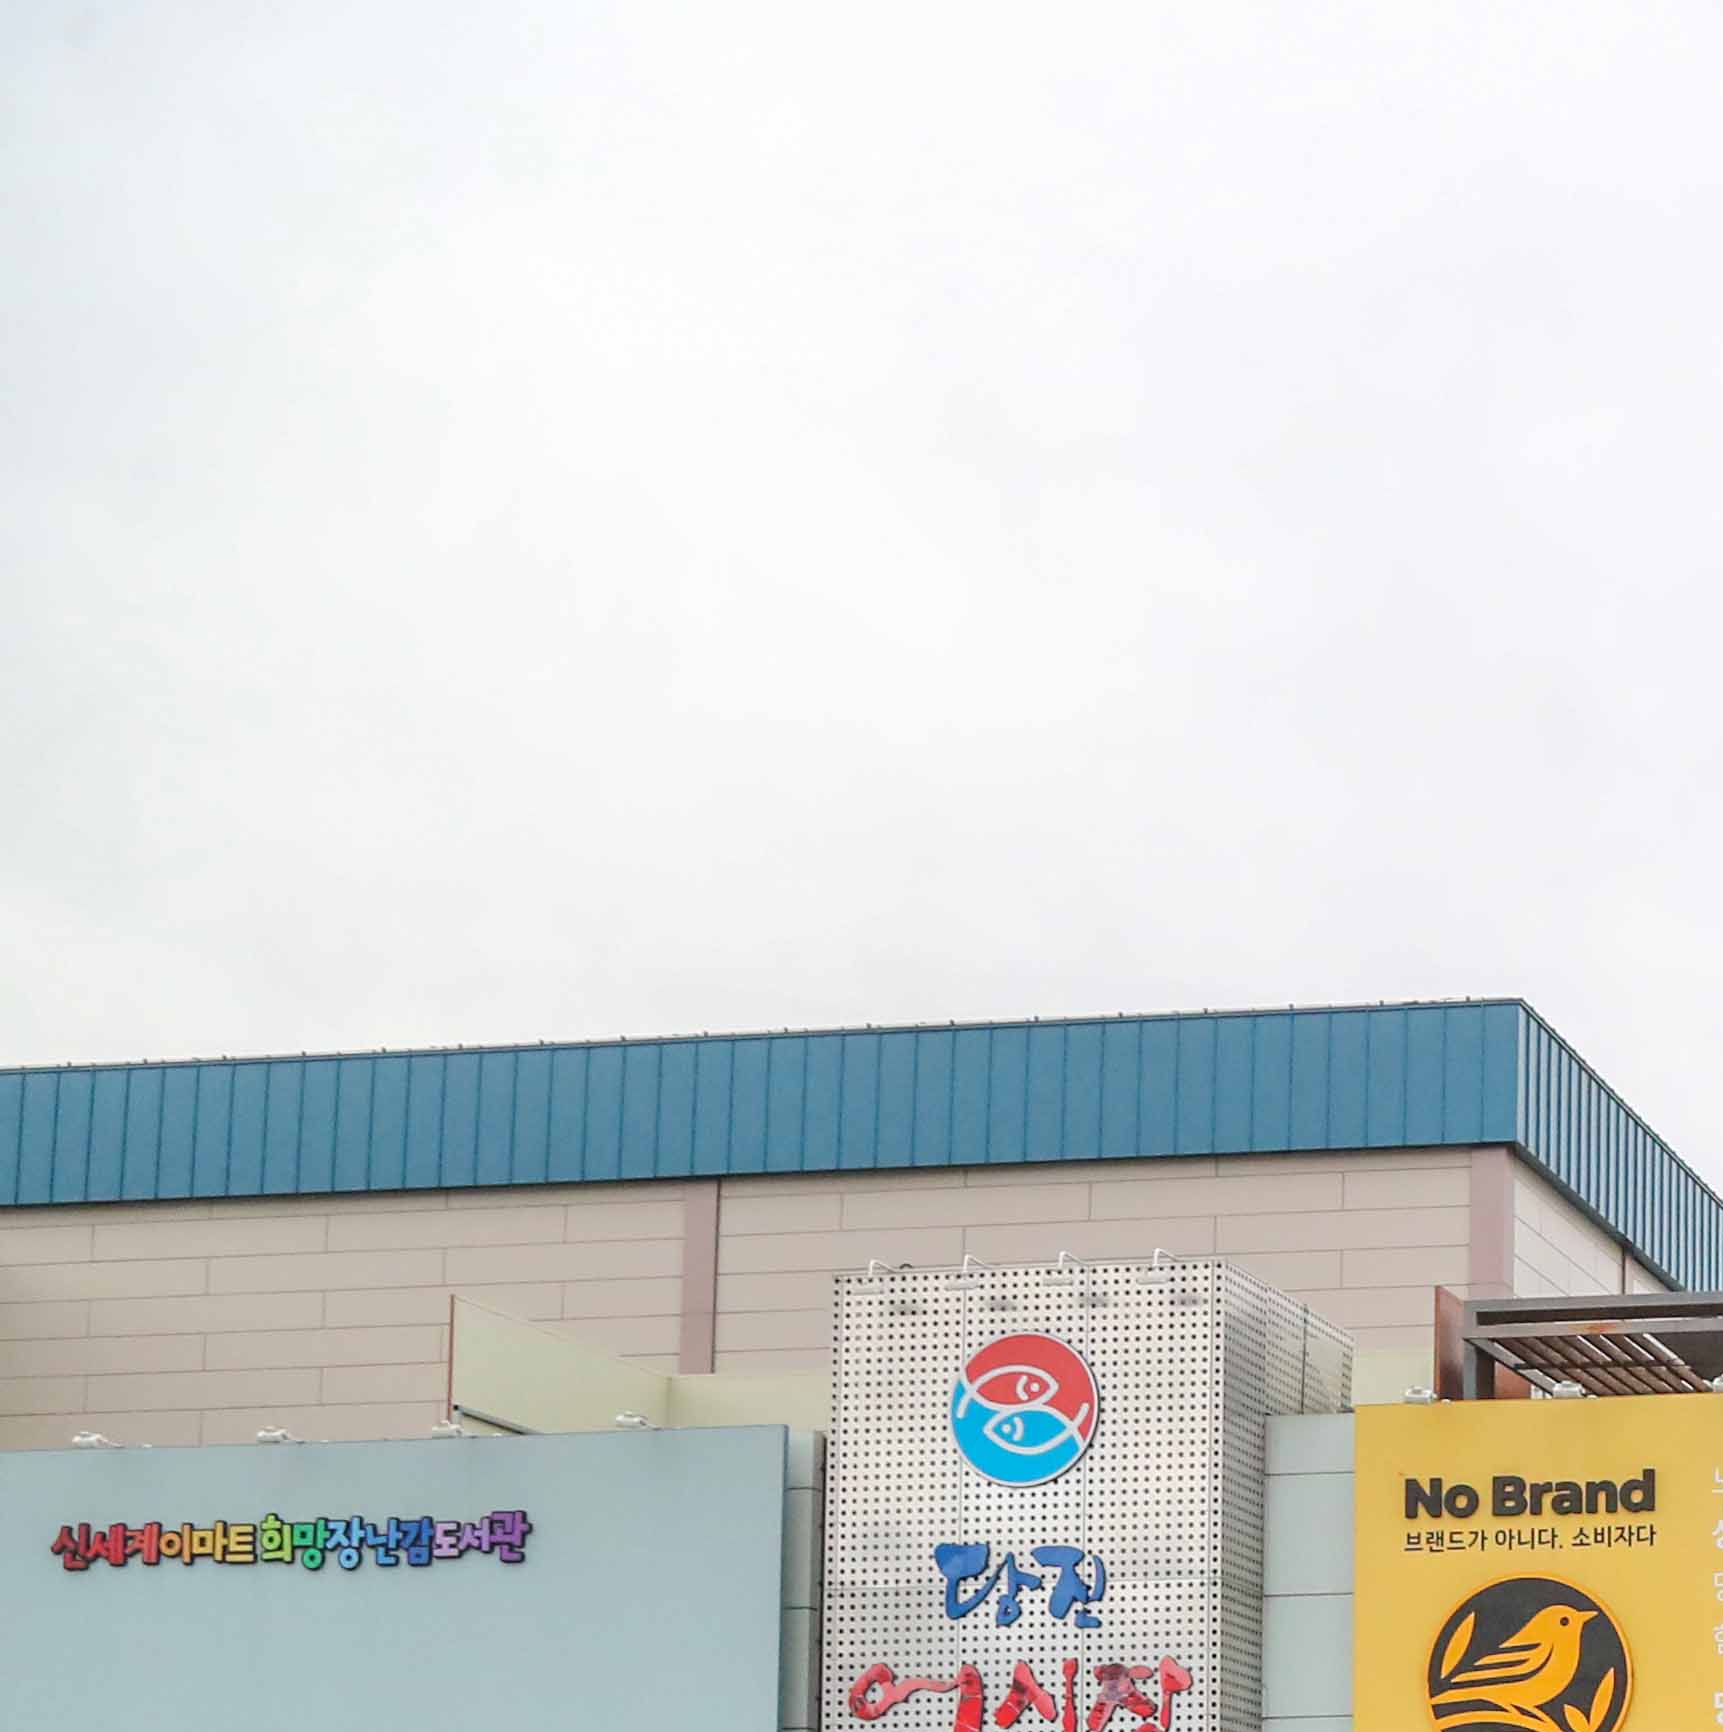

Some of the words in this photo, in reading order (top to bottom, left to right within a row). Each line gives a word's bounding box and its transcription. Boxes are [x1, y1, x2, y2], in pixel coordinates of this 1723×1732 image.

[1403, 1476, 1479, 1520] No
[1490, 1467, 1656, 1518] Brand
[1404, 1527, 1488, 1554] 브랜드가
[1493, 1526, 1564, 1552] 아니다.
[1571, 1522, 1657, 1549] 소비자다
[933, 1541, 1107, 1629] 당진
